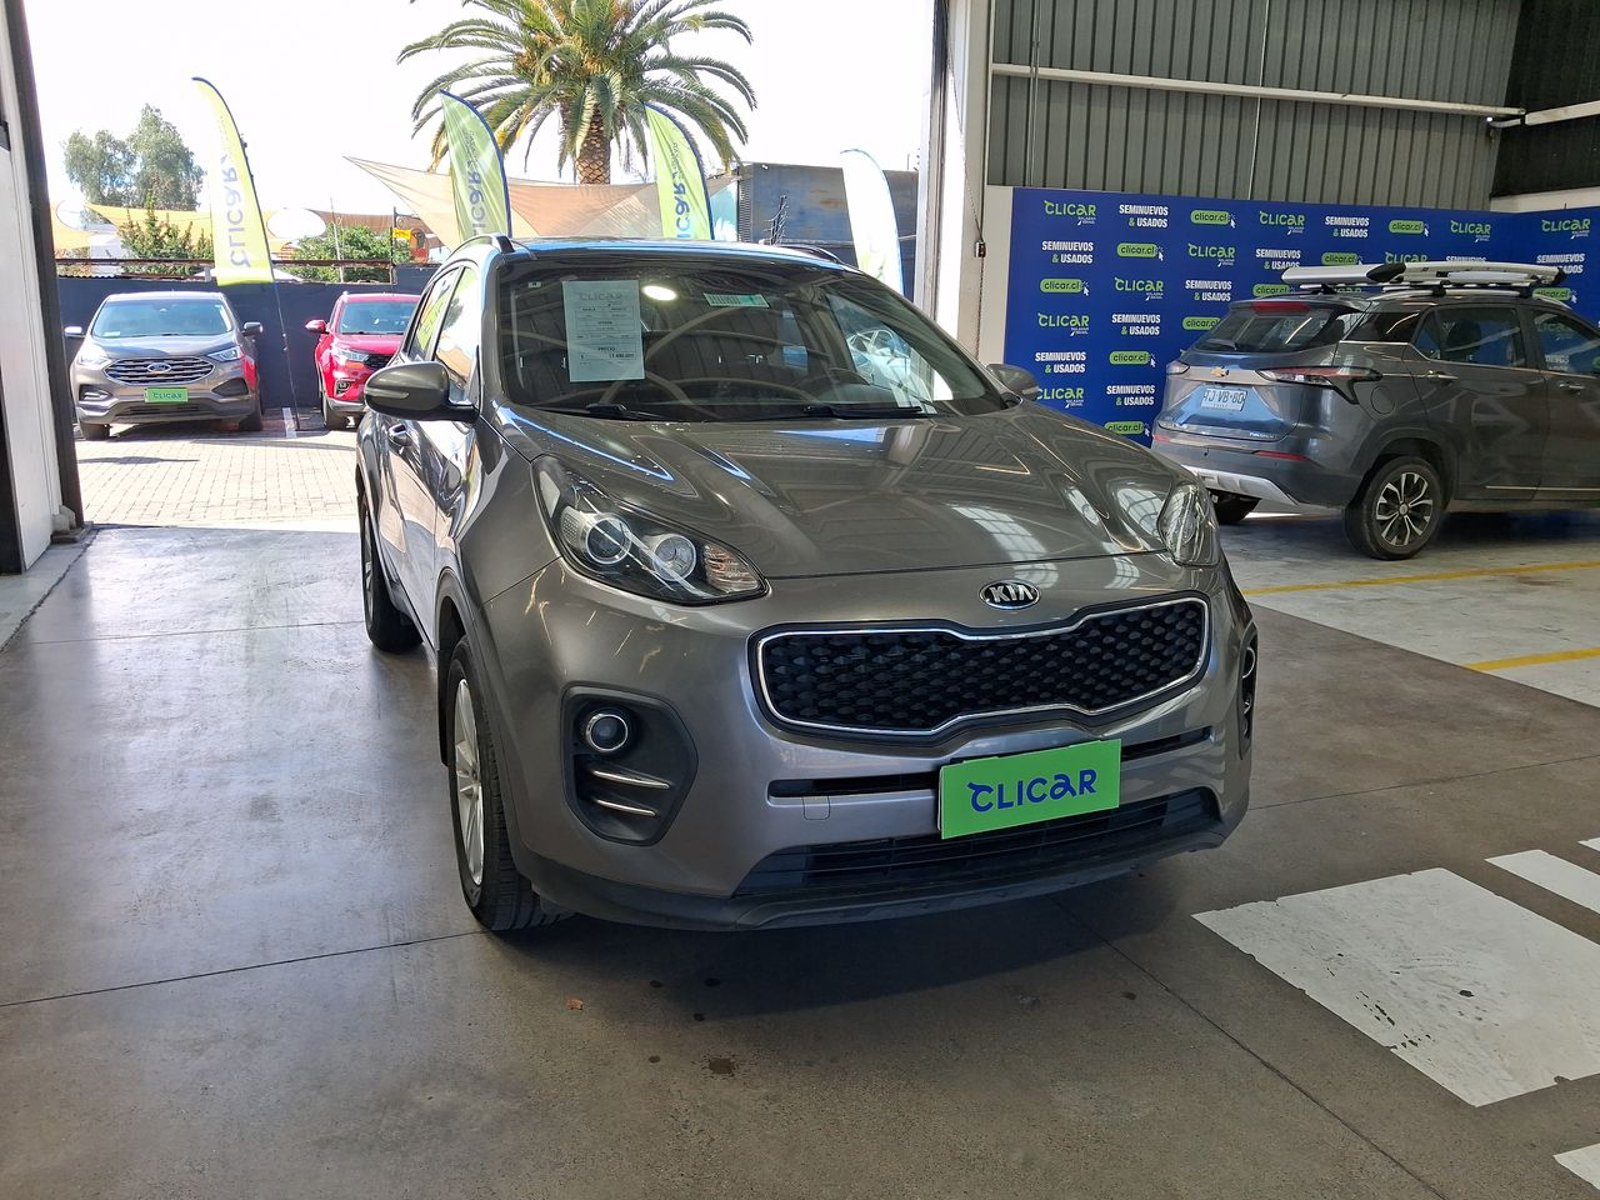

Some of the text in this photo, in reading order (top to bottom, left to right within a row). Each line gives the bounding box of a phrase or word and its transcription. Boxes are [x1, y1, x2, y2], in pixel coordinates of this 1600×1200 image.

[1119, 204, 1169, 216] SEMINUEVOS
[1194, 213, 1227, 222] clicar.cl
[1325, 216, 1370, 227] SEMINUEVOS
[1136, 218, 1168, 229] USADOS
[1340, 228, 1369, 239] USADOS
[1042, 241, 1094, 252] SEMINUEVOS
[1121, 246, 1155, 255] clicar.cl
[1060, 254, 1094, 264] USADOS
[1255, 249, 1302, 260] SEMINUEVOS
[1536, 253, 1586, 264] SEMINUEVOS
[1044, 281, 1080, 290] clicar.cl
[1185, 280, 1232, 291] SEMINUEVOS
[1202, 292, 1232, 302] USADOS
[1111, 314, 1161, 324] SEMINUEVOS
[1129, 326, 1160, 336] USADOS
[1035, 351, 1087, 362] SEMINUEVOS
[1113, 353, 1147, 361] clicar.cl
[1053, 364, 1086, 374] USADOS
[1106, 385, 1156, 395] SEMINUEVOS
[1124, 396, 1155, 406] USADOS
[988, 584, 1034, 603] KIA
